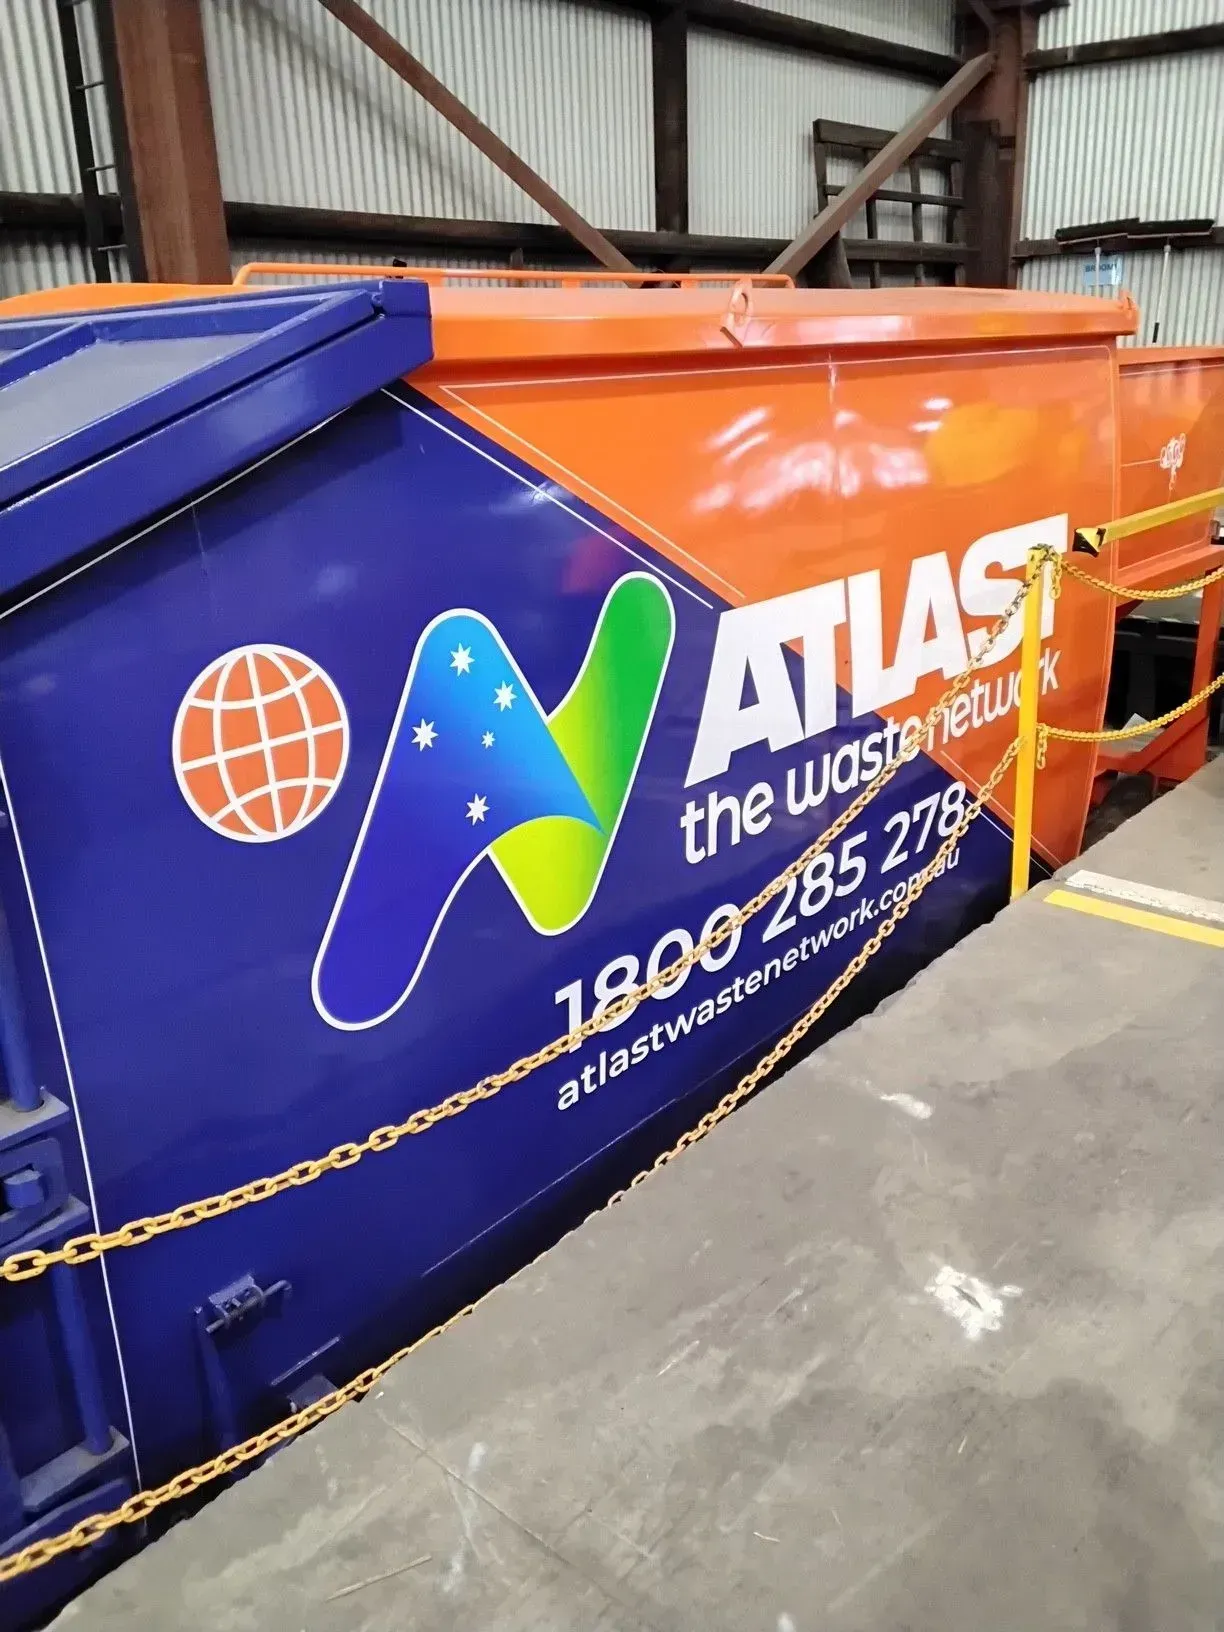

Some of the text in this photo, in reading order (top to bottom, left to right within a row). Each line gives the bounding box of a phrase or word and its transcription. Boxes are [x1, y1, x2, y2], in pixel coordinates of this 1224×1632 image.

[680, 647, 1062, 865] the waste netwk
[684, 513, 1068, 788] ATLAST
[554, 780, 966, 1054] 1800 285 278
[557, 848, 960, 1111] atlastwastenetwork.coau
